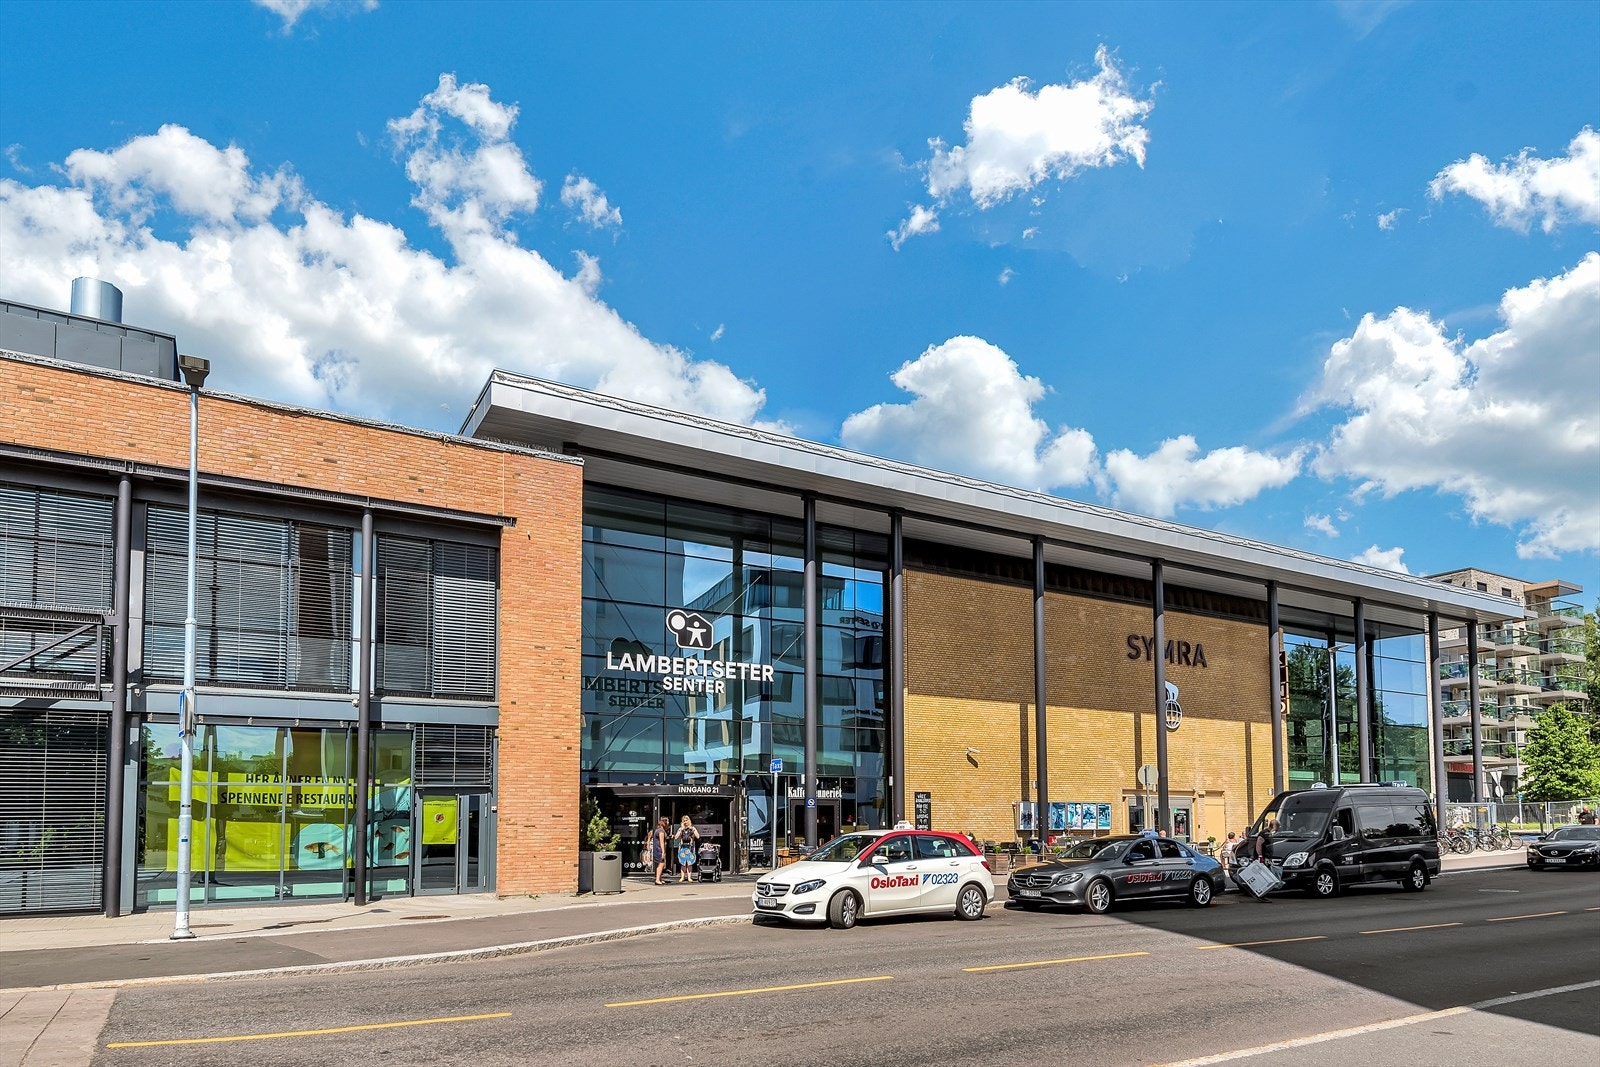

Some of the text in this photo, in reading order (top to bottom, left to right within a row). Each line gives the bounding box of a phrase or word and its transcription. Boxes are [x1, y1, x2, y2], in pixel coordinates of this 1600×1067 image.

[606, 651, 774, 682] LAMBERTSETER
[663, 676, 725, 694] SENTER
[245, 774, 269, 784] HER
[678, 786, 711, 794] INNGANG
[220, 792, 292, 804] SPENNENDE
[871, 872, 959, 889] OsloTaxi 02323
